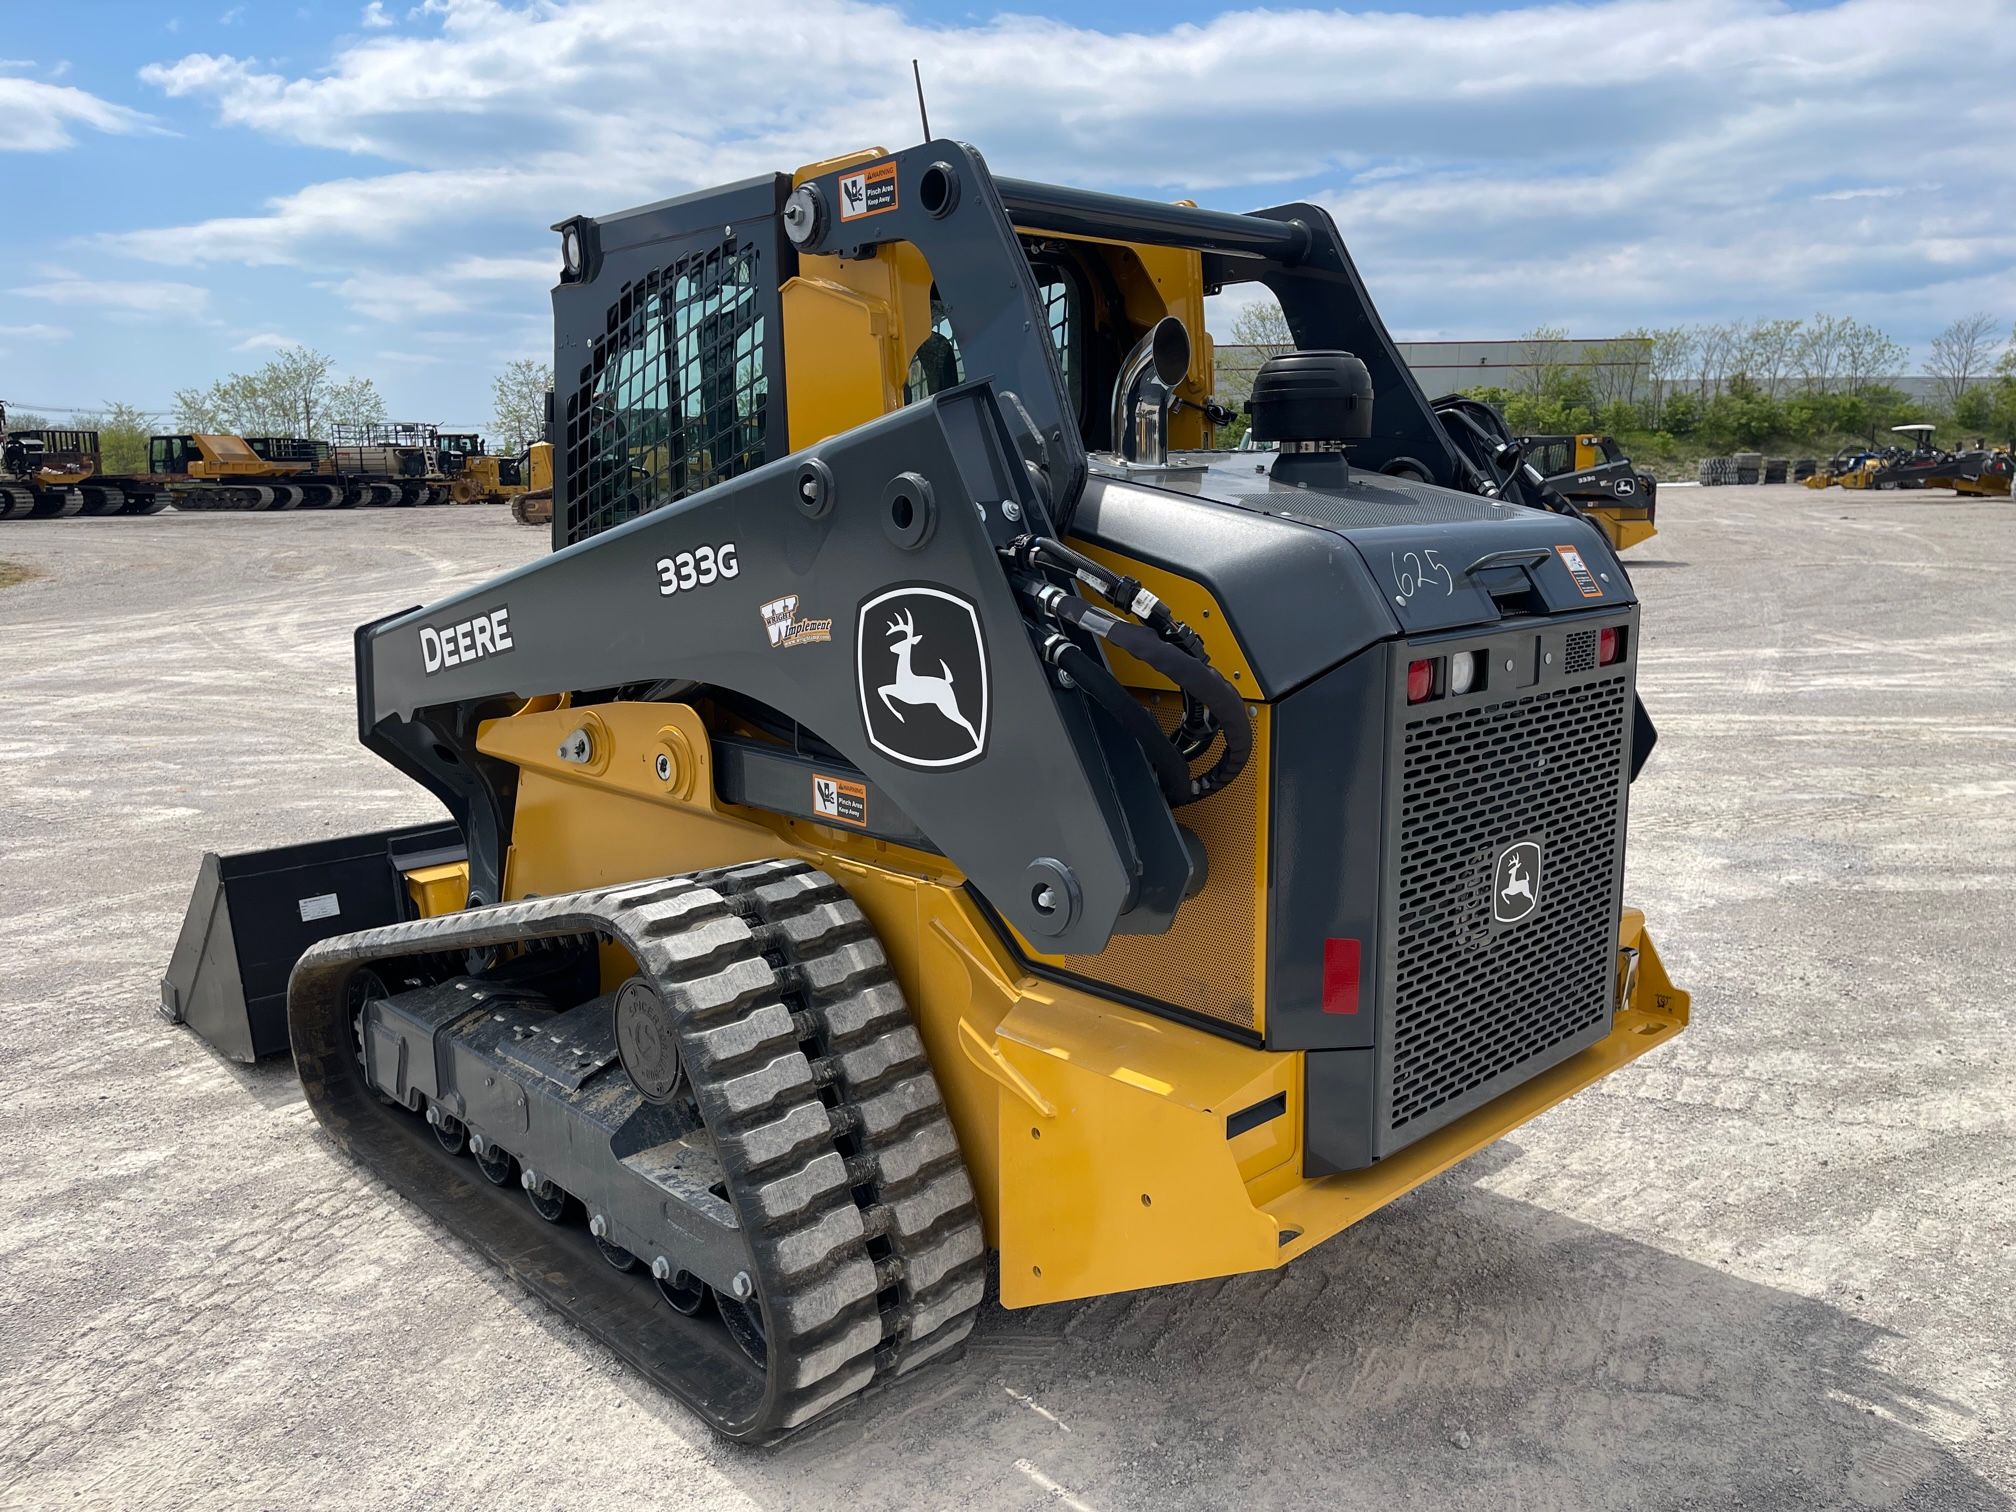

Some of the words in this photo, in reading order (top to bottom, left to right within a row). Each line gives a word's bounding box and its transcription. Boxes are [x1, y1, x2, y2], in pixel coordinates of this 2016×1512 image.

[867, 187, 881, 196] Pinch
[882, 185, 893, 193] Area
[868, 198, 879, 206] Keep
[656, 543, 739, 595] 333G
[1391, 549, 1453, 597] 625
[765, 611, 792, 626] WRIGHT
[784, 620, 831, 638] Implement
[420, 608, 513, 673] DEERE
[838, 797, 851, 806] Pinch
[851, 801, 863, 809] Area
[838, 806, 848, 814] Keep
[849, 809, 860, 817] Away
[629, 1001, 660, 1026] SPICER
